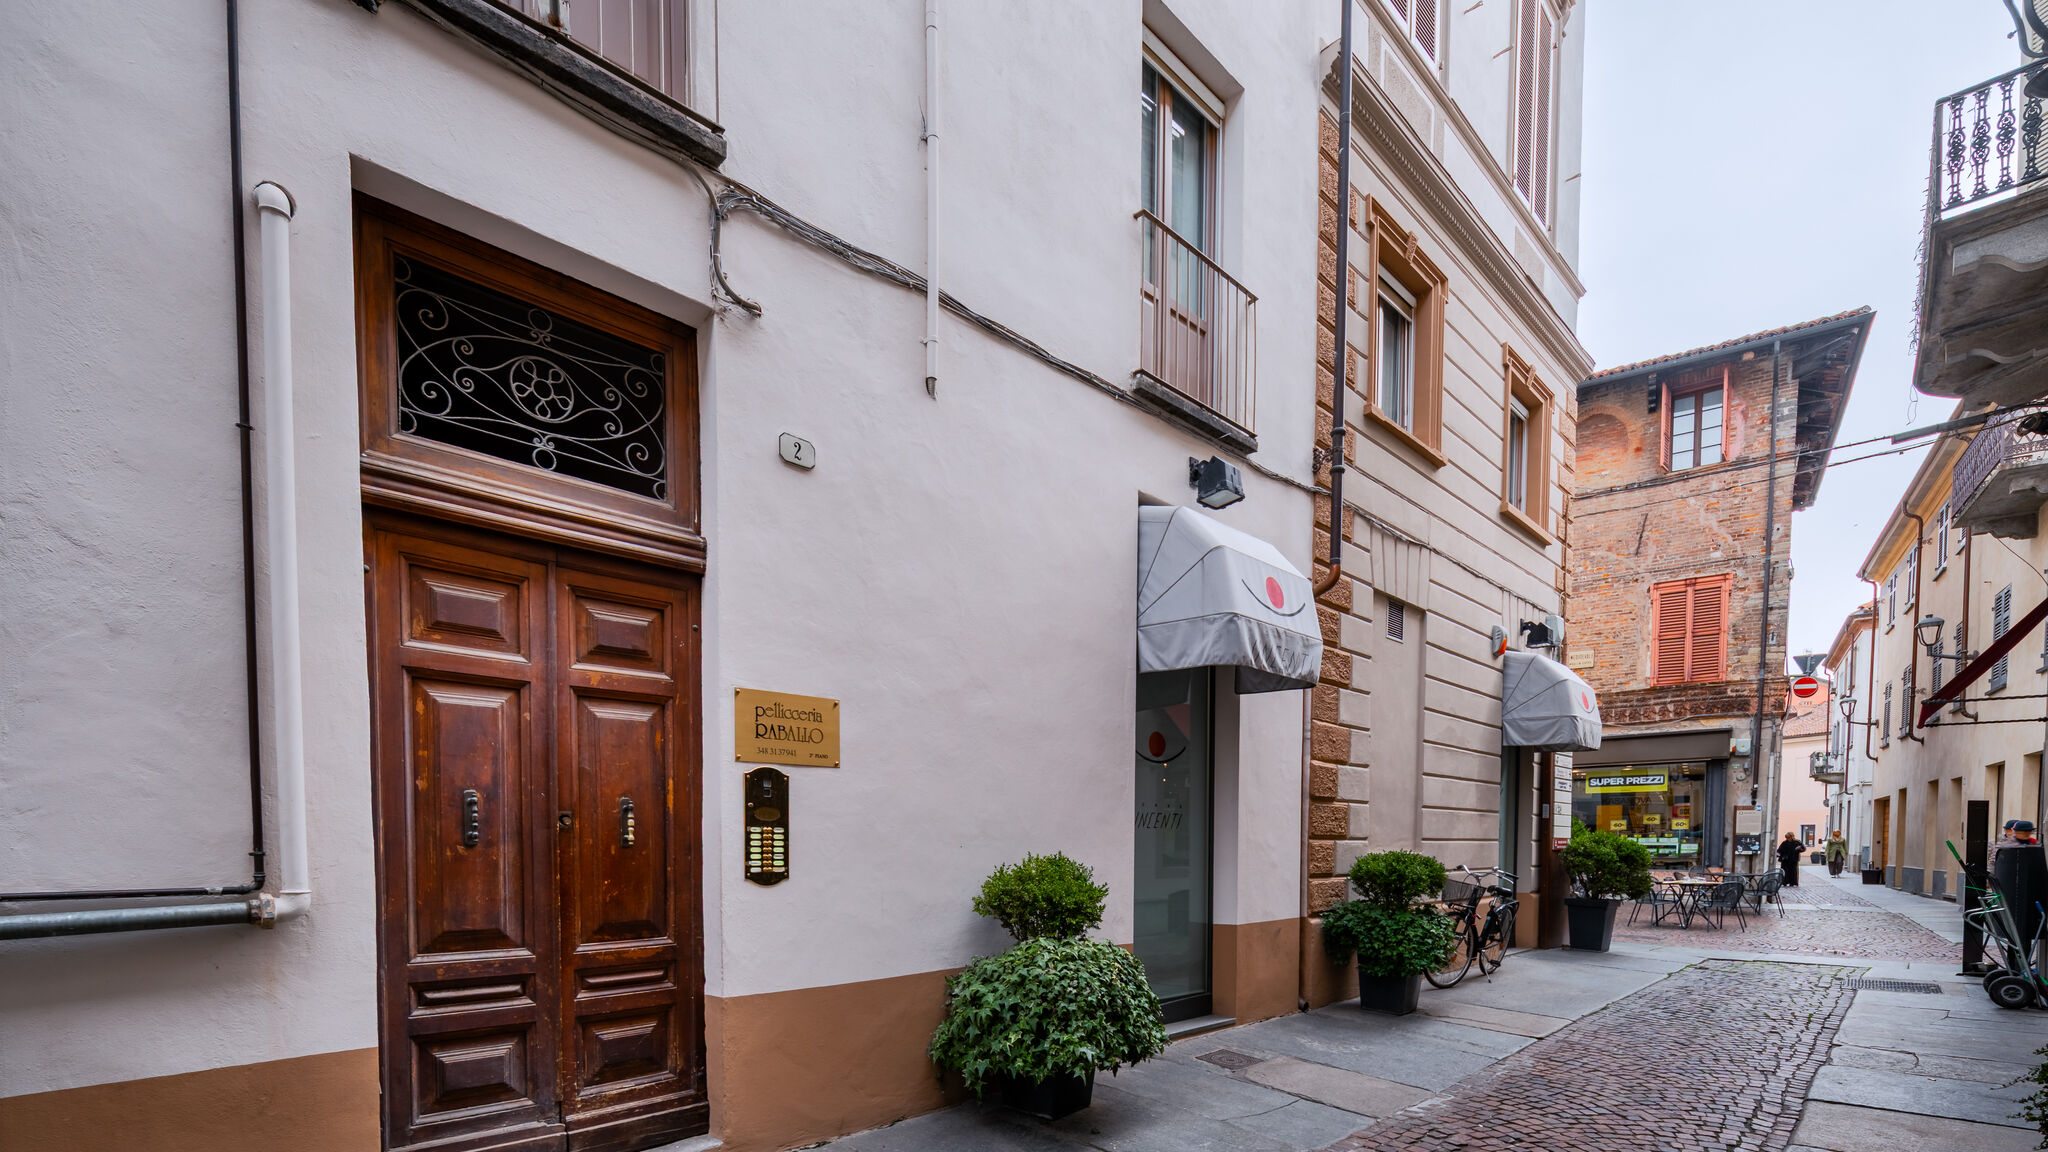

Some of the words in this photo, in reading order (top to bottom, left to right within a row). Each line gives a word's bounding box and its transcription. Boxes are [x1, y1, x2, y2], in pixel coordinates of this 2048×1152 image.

[793, 441, 802, 461] 2
[754, 723, 824, 744] RABALLO
[756, 746, 769, 755] 348
[769, 747, 797, 757] 3137941
[1589, 777, 1624, 787] SUPER
[1625, 775, 1664, 785] PREZZI
